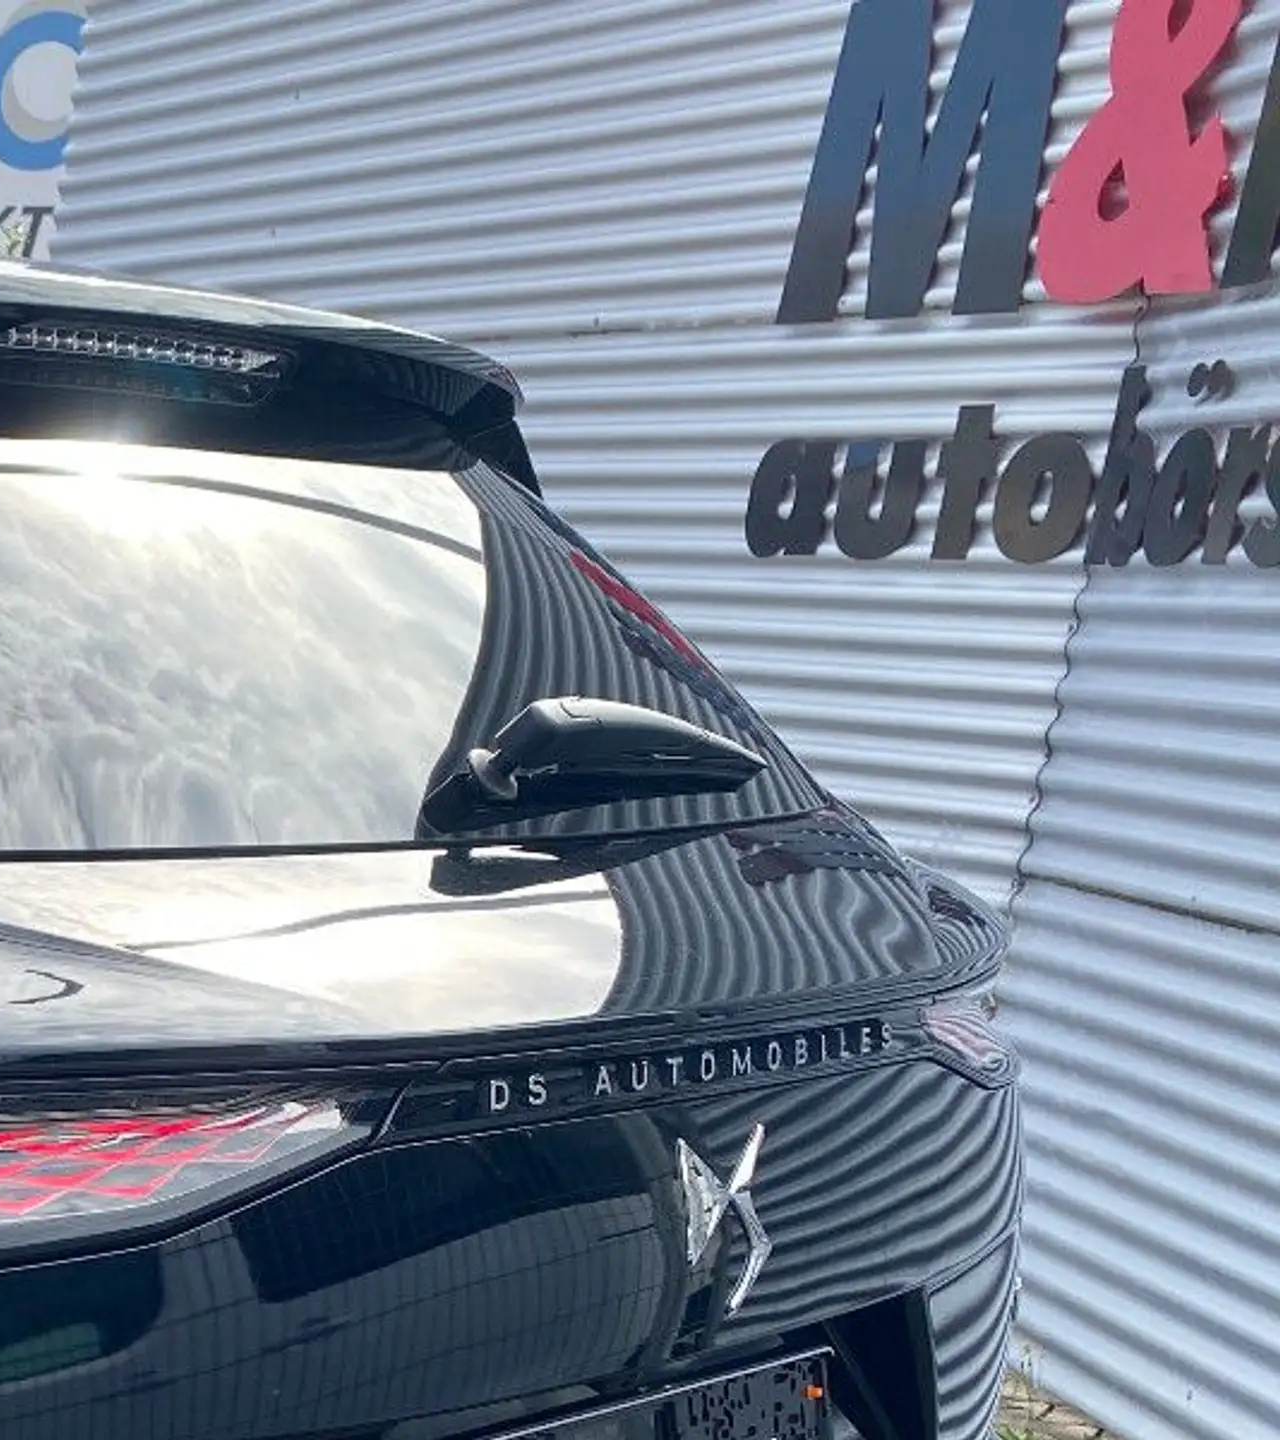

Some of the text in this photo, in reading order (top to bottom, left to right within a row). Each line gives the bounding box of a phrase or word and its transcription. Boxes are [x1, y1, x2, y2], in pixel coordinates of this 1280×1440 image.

[776, 0, 1280, 323] M&
[490, 1023, 894, 1111] DS AUTOMOBILES
